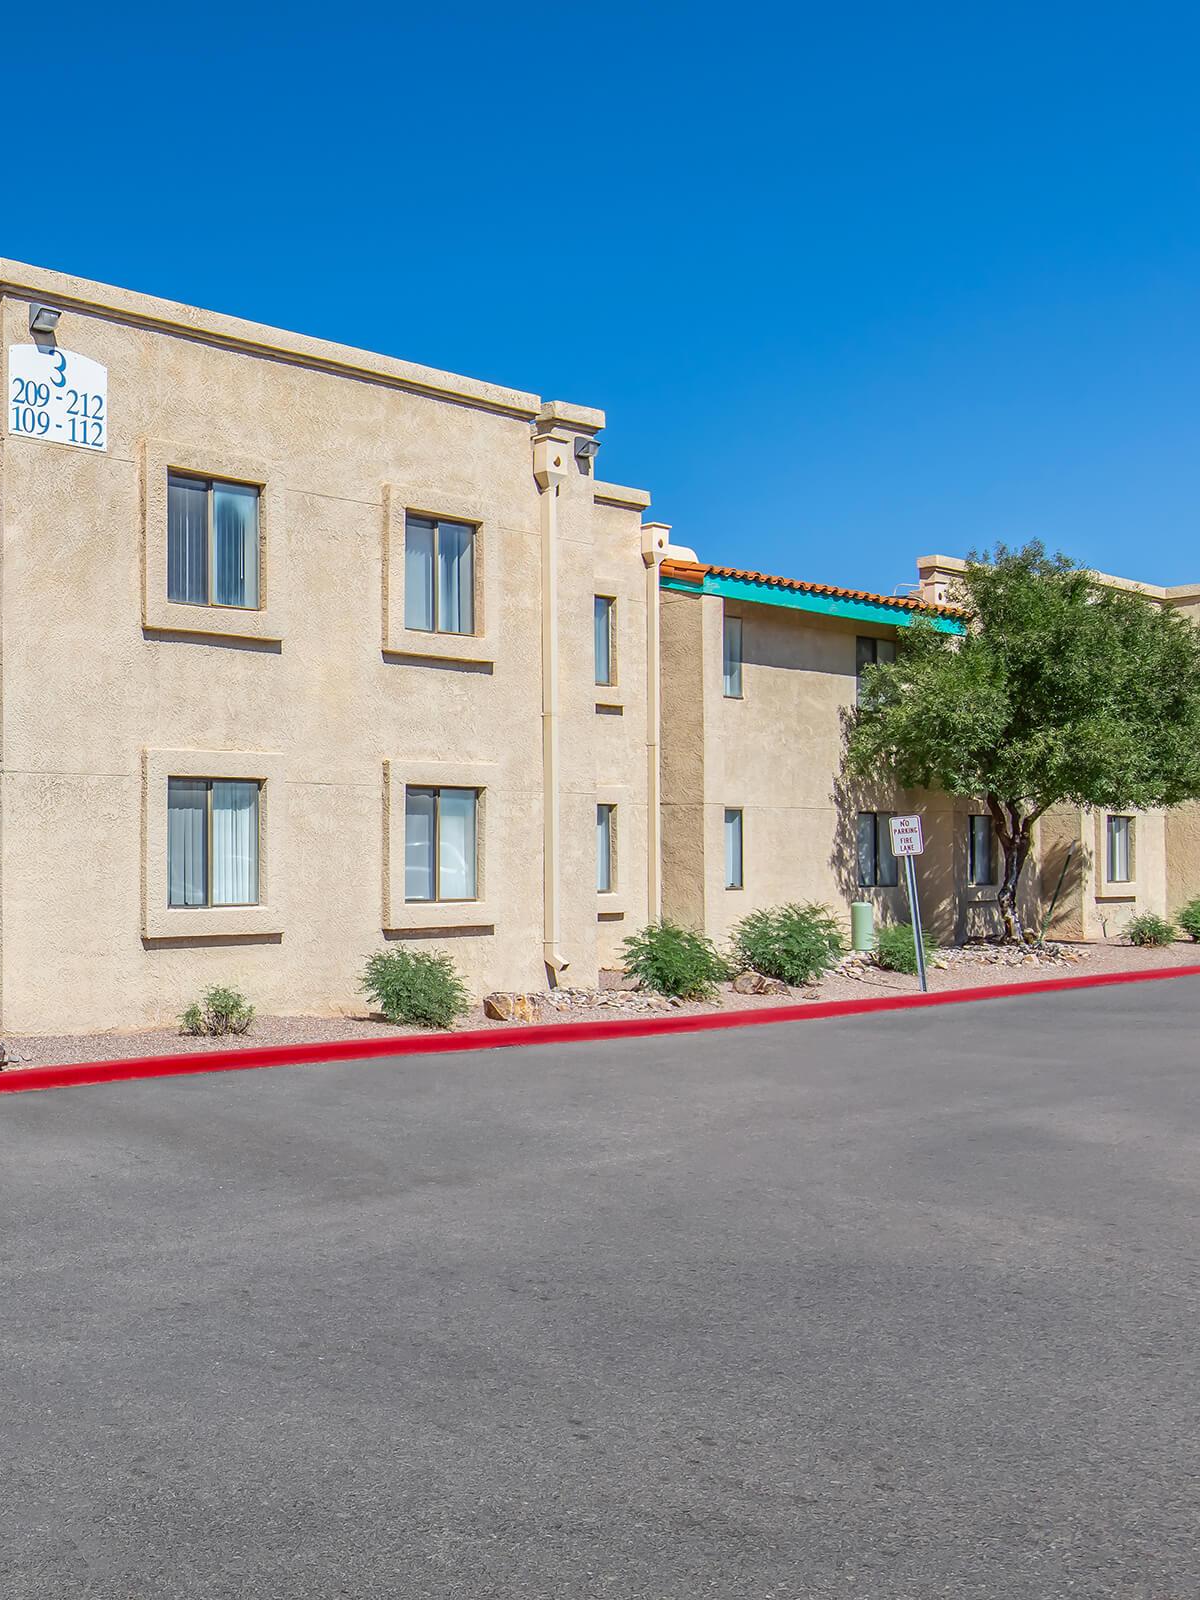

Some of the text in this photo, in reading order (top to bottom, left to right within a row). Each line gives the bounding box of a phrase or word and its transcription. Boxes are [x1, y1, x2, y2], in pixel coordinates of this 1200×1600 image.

[48, 350, 67, 388] 3
[12, 377, 50, 408] 209
[66, 389, 105, 421] 212
[12, 406, 50, 435] 109
[68, 417, 104, 447] 112
[894, 827, 918, 835] PARKING
[900, 819, 910, 827] NO
